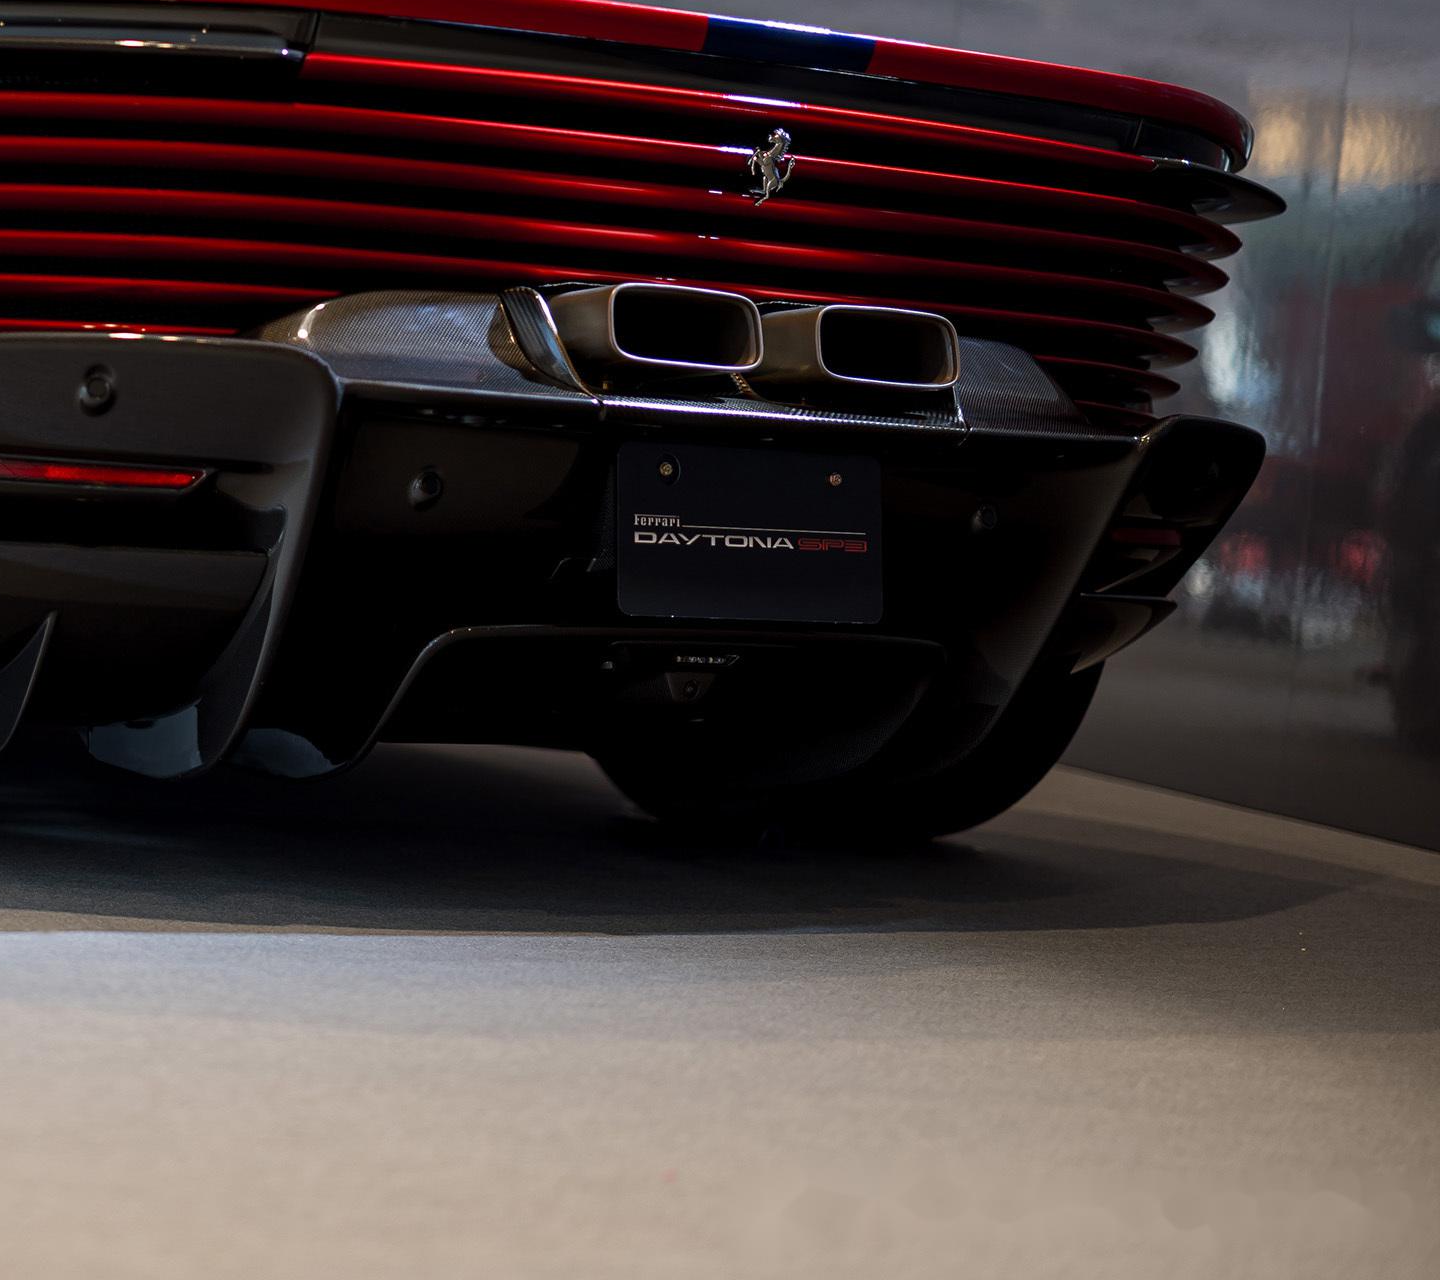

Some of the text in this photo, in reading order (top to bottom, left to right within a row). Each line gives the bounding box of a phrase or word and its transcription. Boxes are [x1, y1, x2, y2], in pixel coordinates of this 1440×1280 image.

[633, 513, 681, 528] Ferrari
[634, 531, 868, 553] DAYTONA SP3
